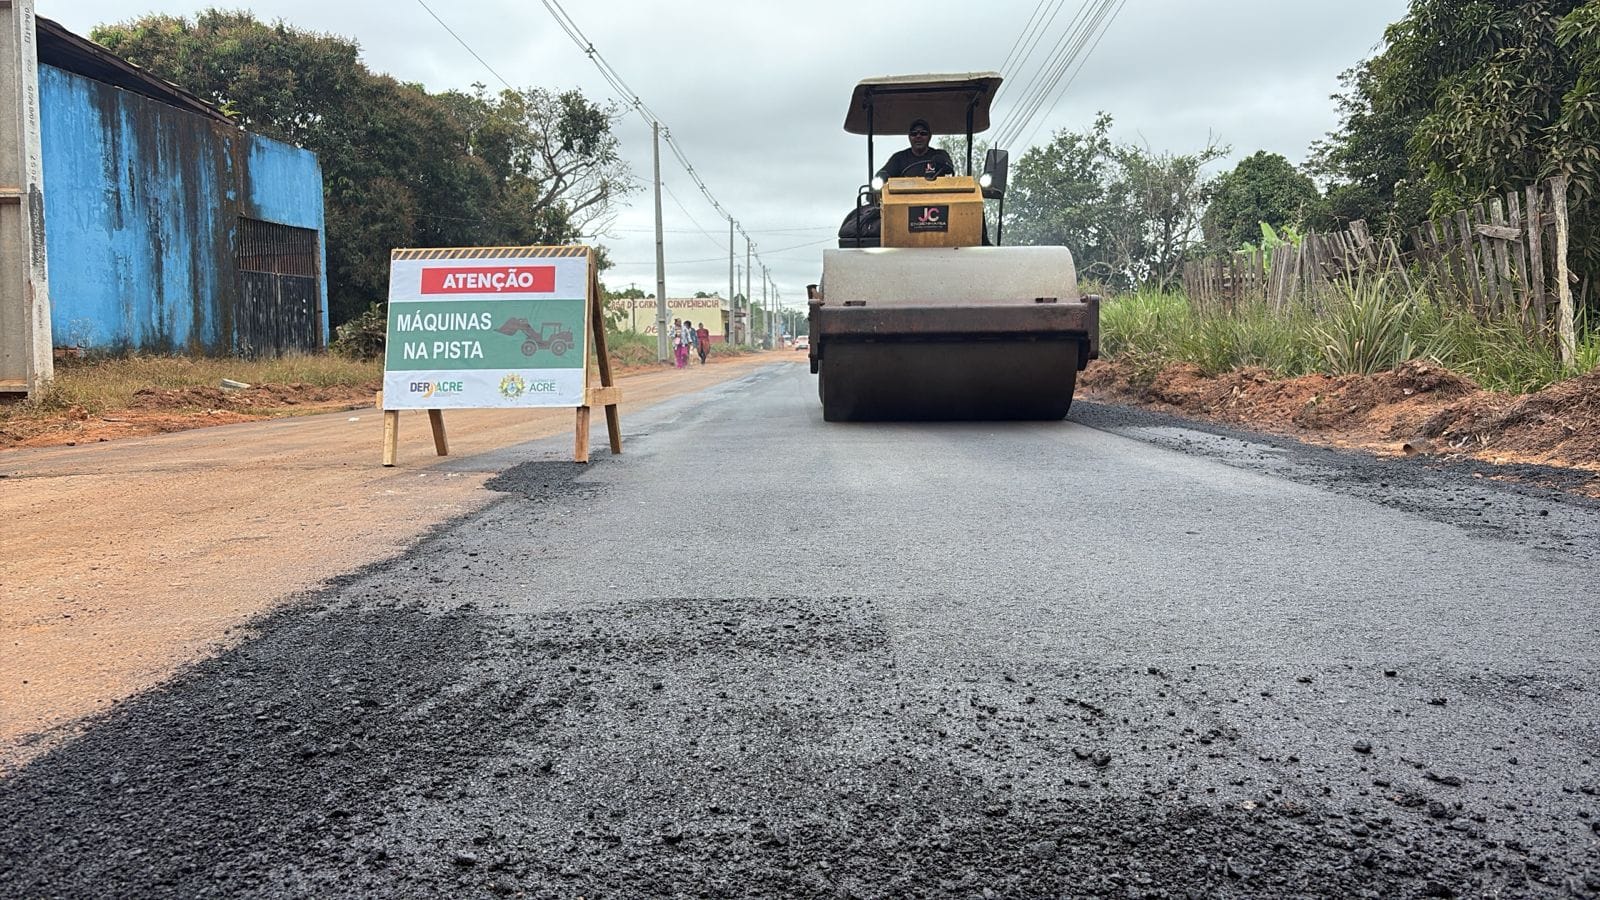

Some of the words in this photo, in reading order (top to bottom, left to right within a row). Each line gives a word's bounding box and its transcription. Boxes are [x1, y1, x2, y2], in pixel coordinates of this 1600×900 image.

[918, 207, 940, 221] JC
[443, 268, 534, 291] ATENÇÃO
[397, 310, 492, 331] MÁQUINAS
[404, 342, 428, 359] NA
[433, 341, 483, 359] PISTA
[529, 382, 556, 392] ACRE
